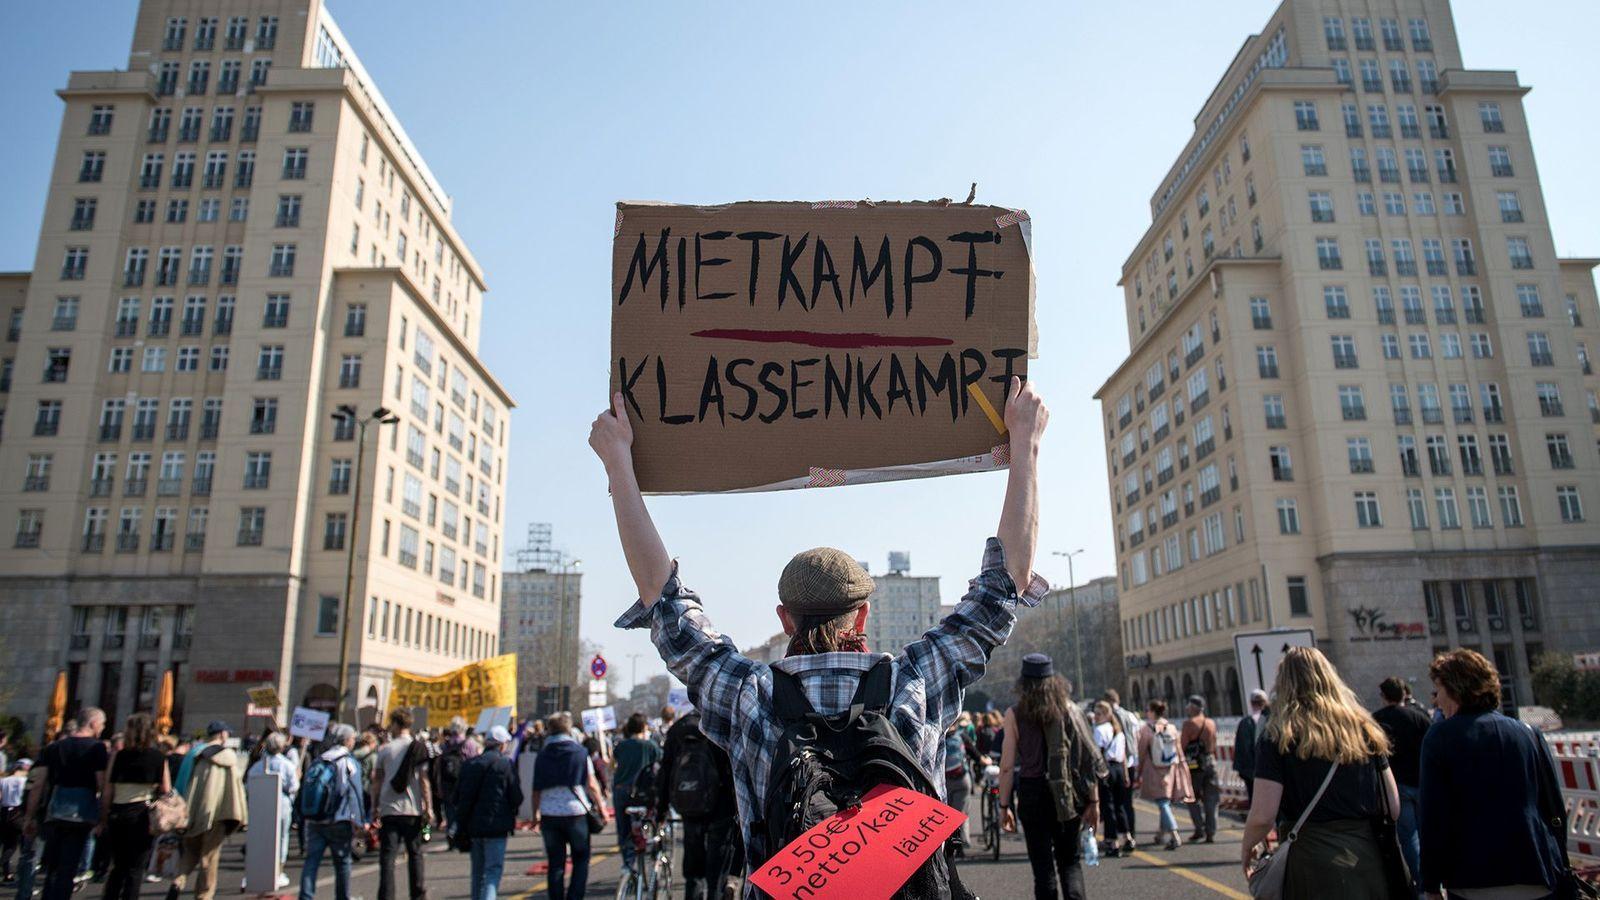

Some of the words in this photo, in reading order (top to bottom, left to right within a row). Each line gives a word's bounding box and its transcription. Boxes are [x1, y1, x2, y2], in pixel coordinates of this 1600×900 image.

[618, 226, 1005, 321] MIETKAMPF
[618, 348, 1028, 429] KLASSENKAMPF
[767, 818, 850, 886] 3,50€
[791, 794, 915, 900] netto/kalt
[892, 808, 950, 858] läuft!
